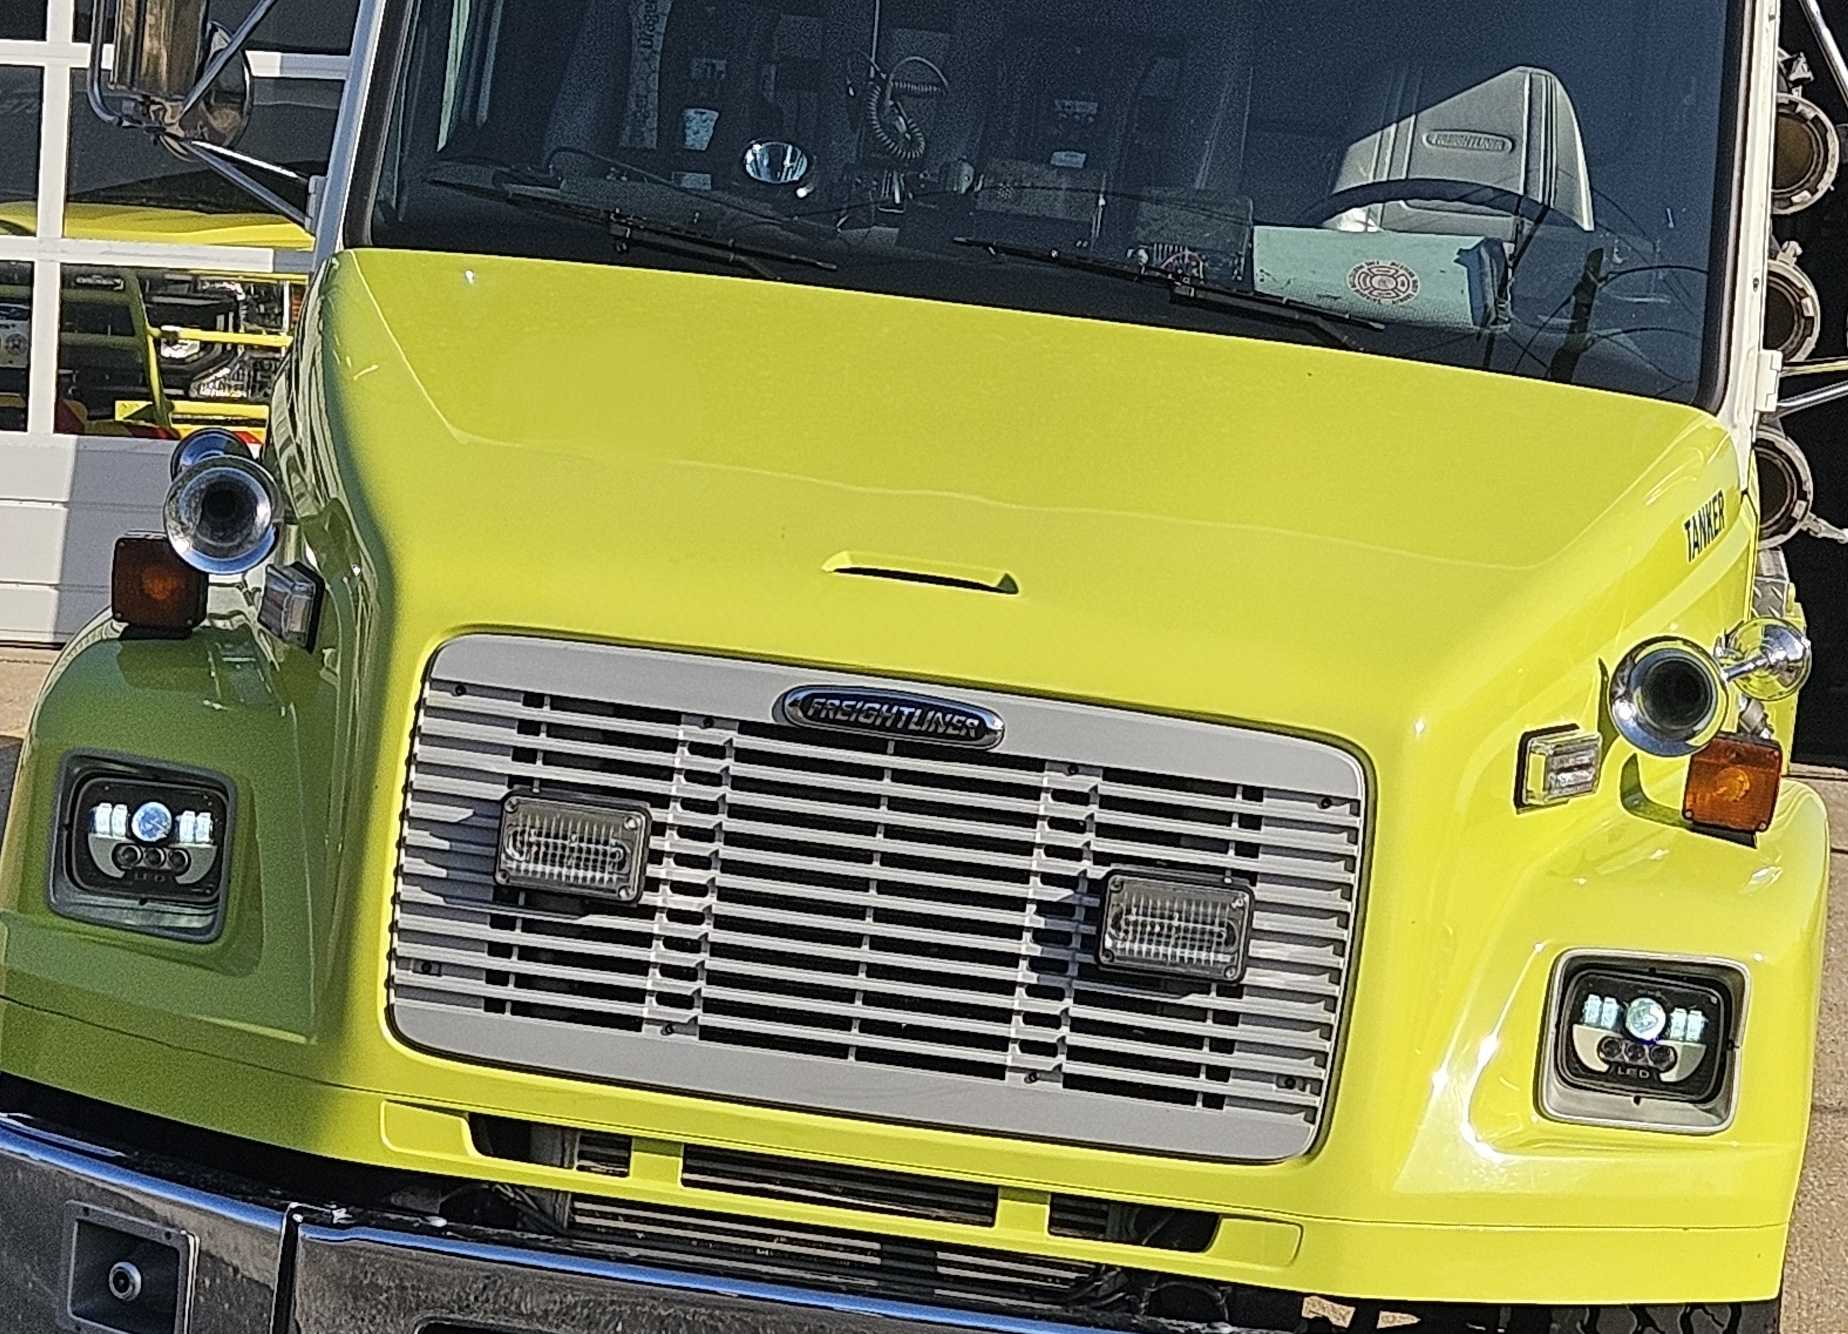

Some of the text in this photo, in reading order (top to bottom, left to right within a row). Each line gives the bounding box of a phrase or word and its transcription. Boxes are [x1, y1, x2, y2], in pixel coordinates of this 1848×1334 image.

[1684, 489, 1725, 562] TANKER
[807, 697, 980, 738] FREIGHTLINER
[1616, 1066, 1650, 1078] LED
